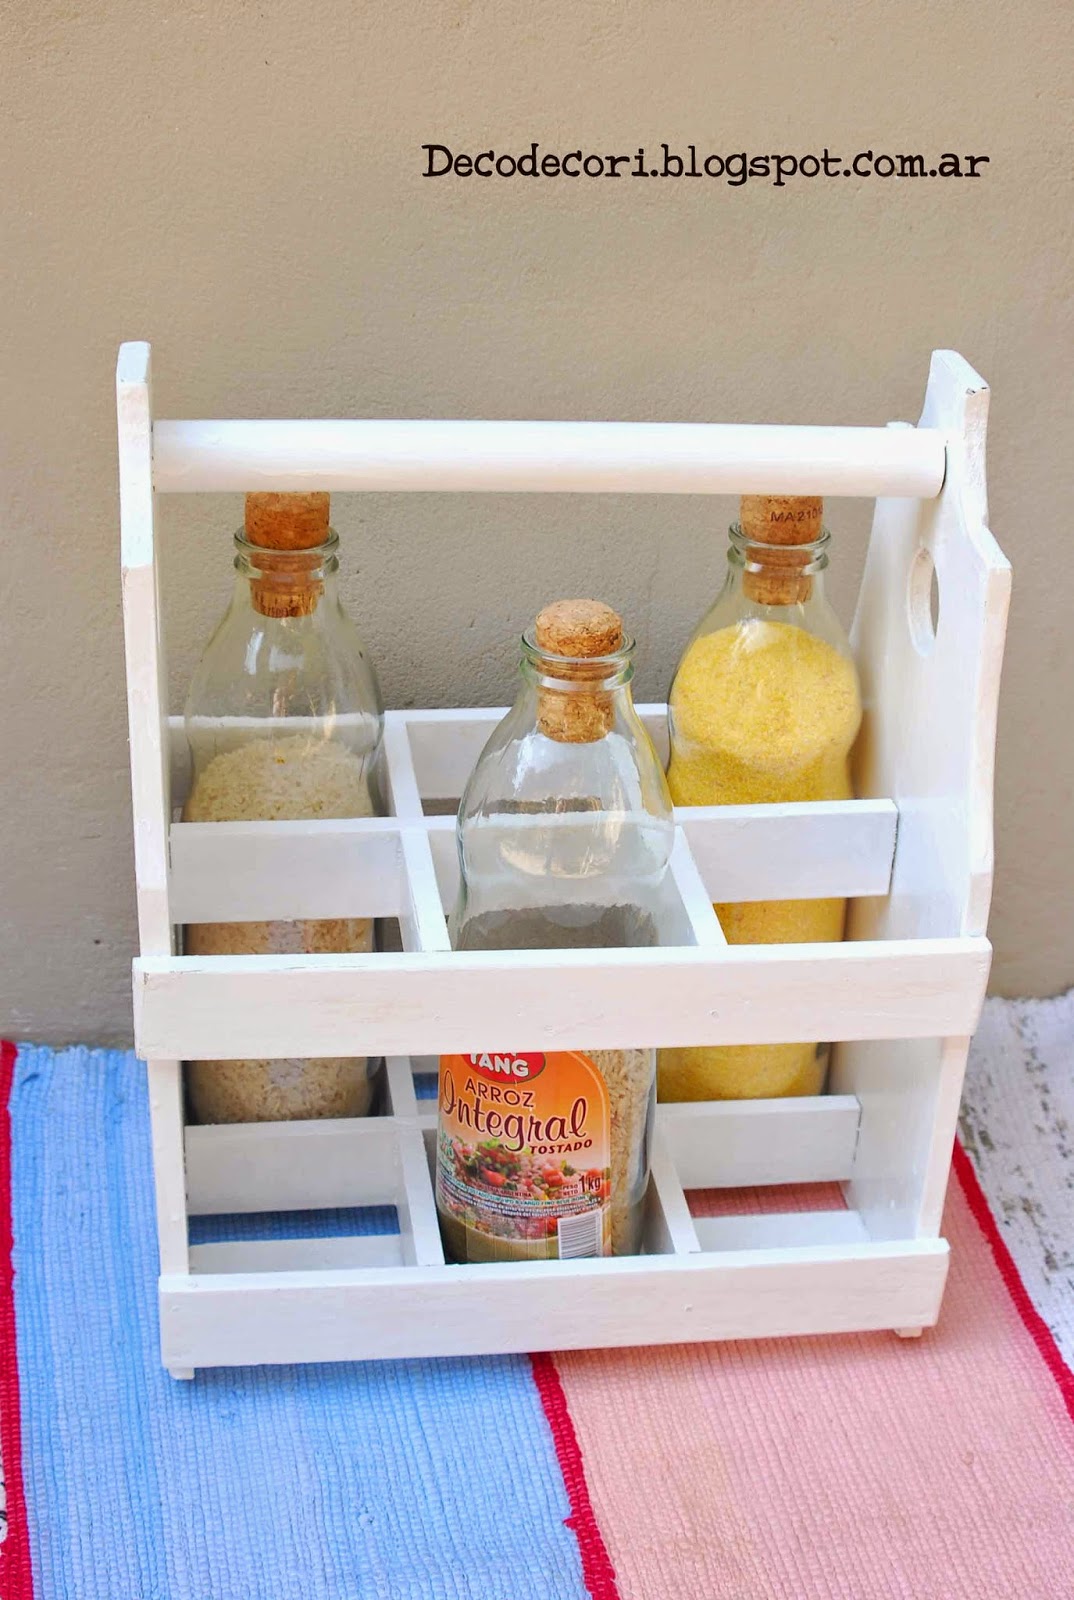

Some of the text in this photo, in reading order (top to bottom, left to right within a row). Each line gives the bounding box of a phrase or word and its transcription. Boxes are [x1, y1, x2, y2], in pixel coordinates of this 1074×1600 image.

[465, 1078, 534, 1108] ARROZ
[443, 1070, 587, 1152] Integral
[530, 1139, 593, 1155] TOSTADO
